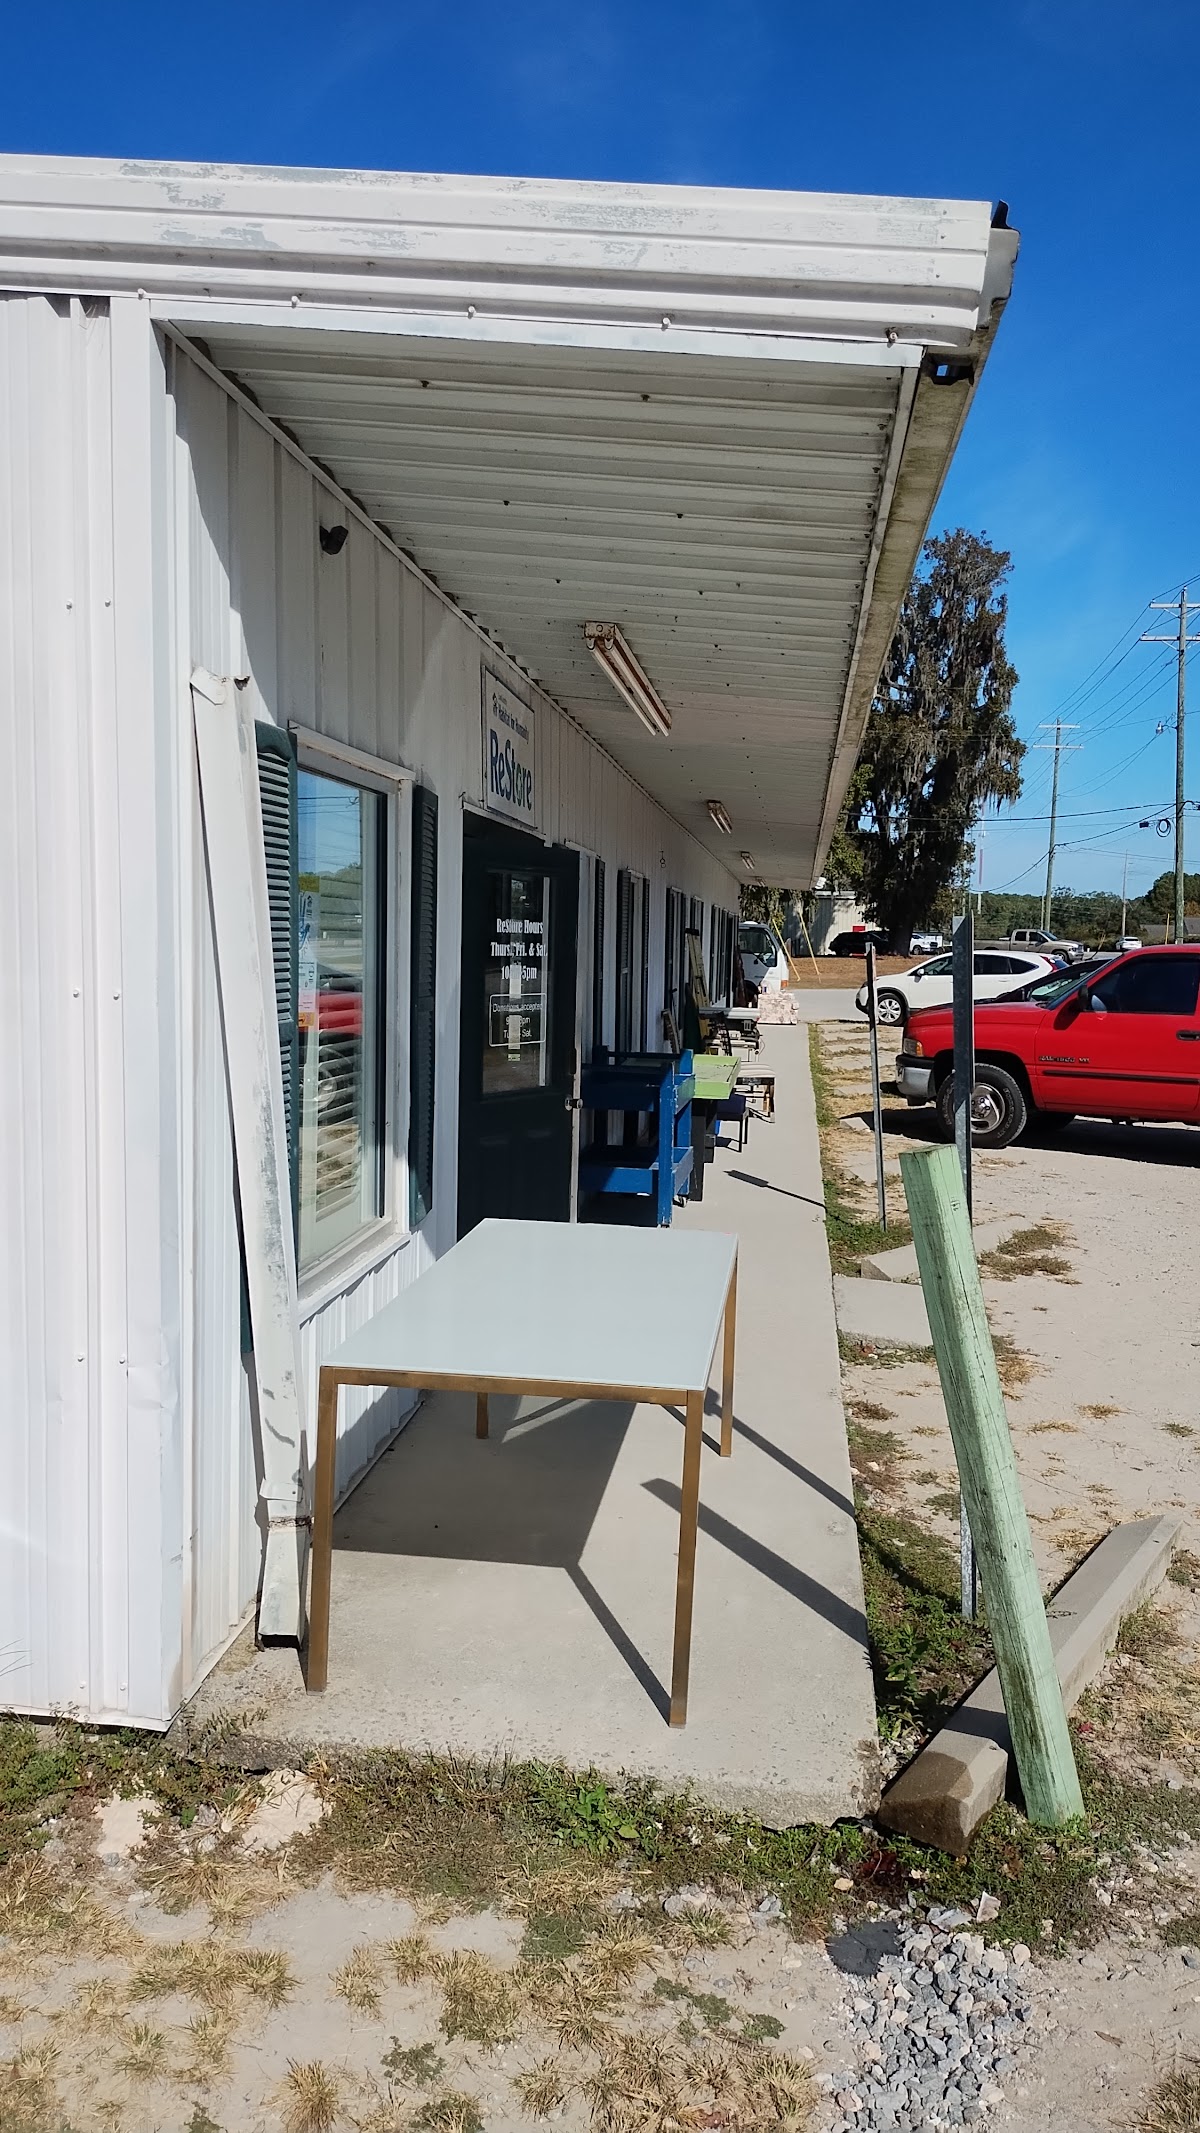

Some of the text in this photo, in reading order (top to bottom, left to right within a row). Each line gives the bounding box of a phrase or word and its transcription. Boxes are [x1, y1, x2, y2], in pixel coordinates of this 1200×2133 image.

[489, 728, 532, 811] ReStore
[496, 918, 544, 934] ReStore Hours
[515, 942, 528, 957] Fri.
[528, 942, 535, 957] &
[535, 942, 548, 957] Sat.
[492, 1003, 543, 1013] Donations accepted
